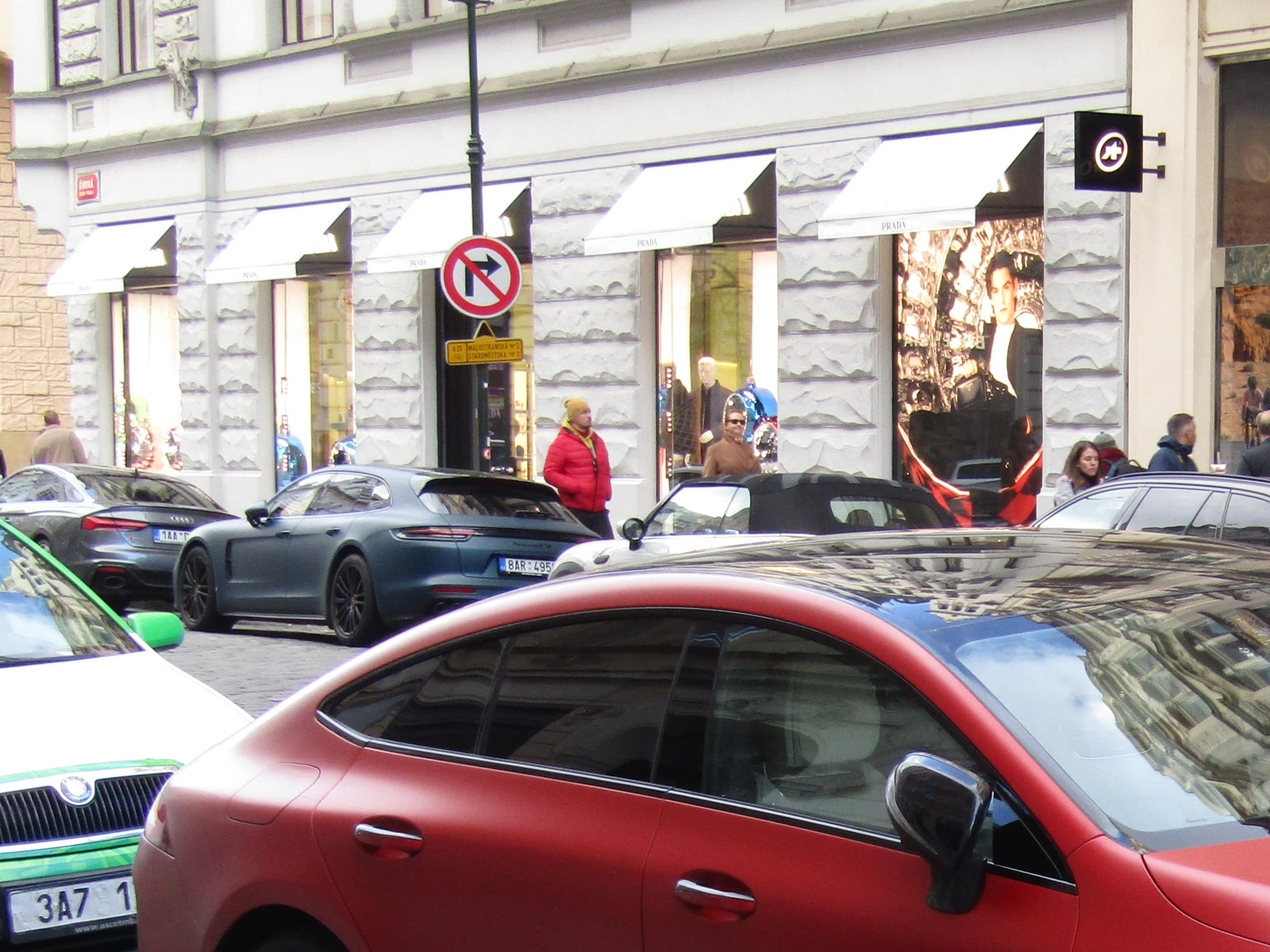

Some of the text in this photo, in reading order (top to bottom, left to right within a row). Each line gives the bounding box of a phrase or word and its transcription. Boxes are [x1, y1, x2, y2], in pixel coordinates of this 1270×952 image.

[881, 221, 907, 231] PRADA
[637, 238, 658, 248] PRADA
[162, 530, 178, 541] 1AA
[508, 559, 555, 573] 8AR 495
[37, 886, 91, 924] 3A7
